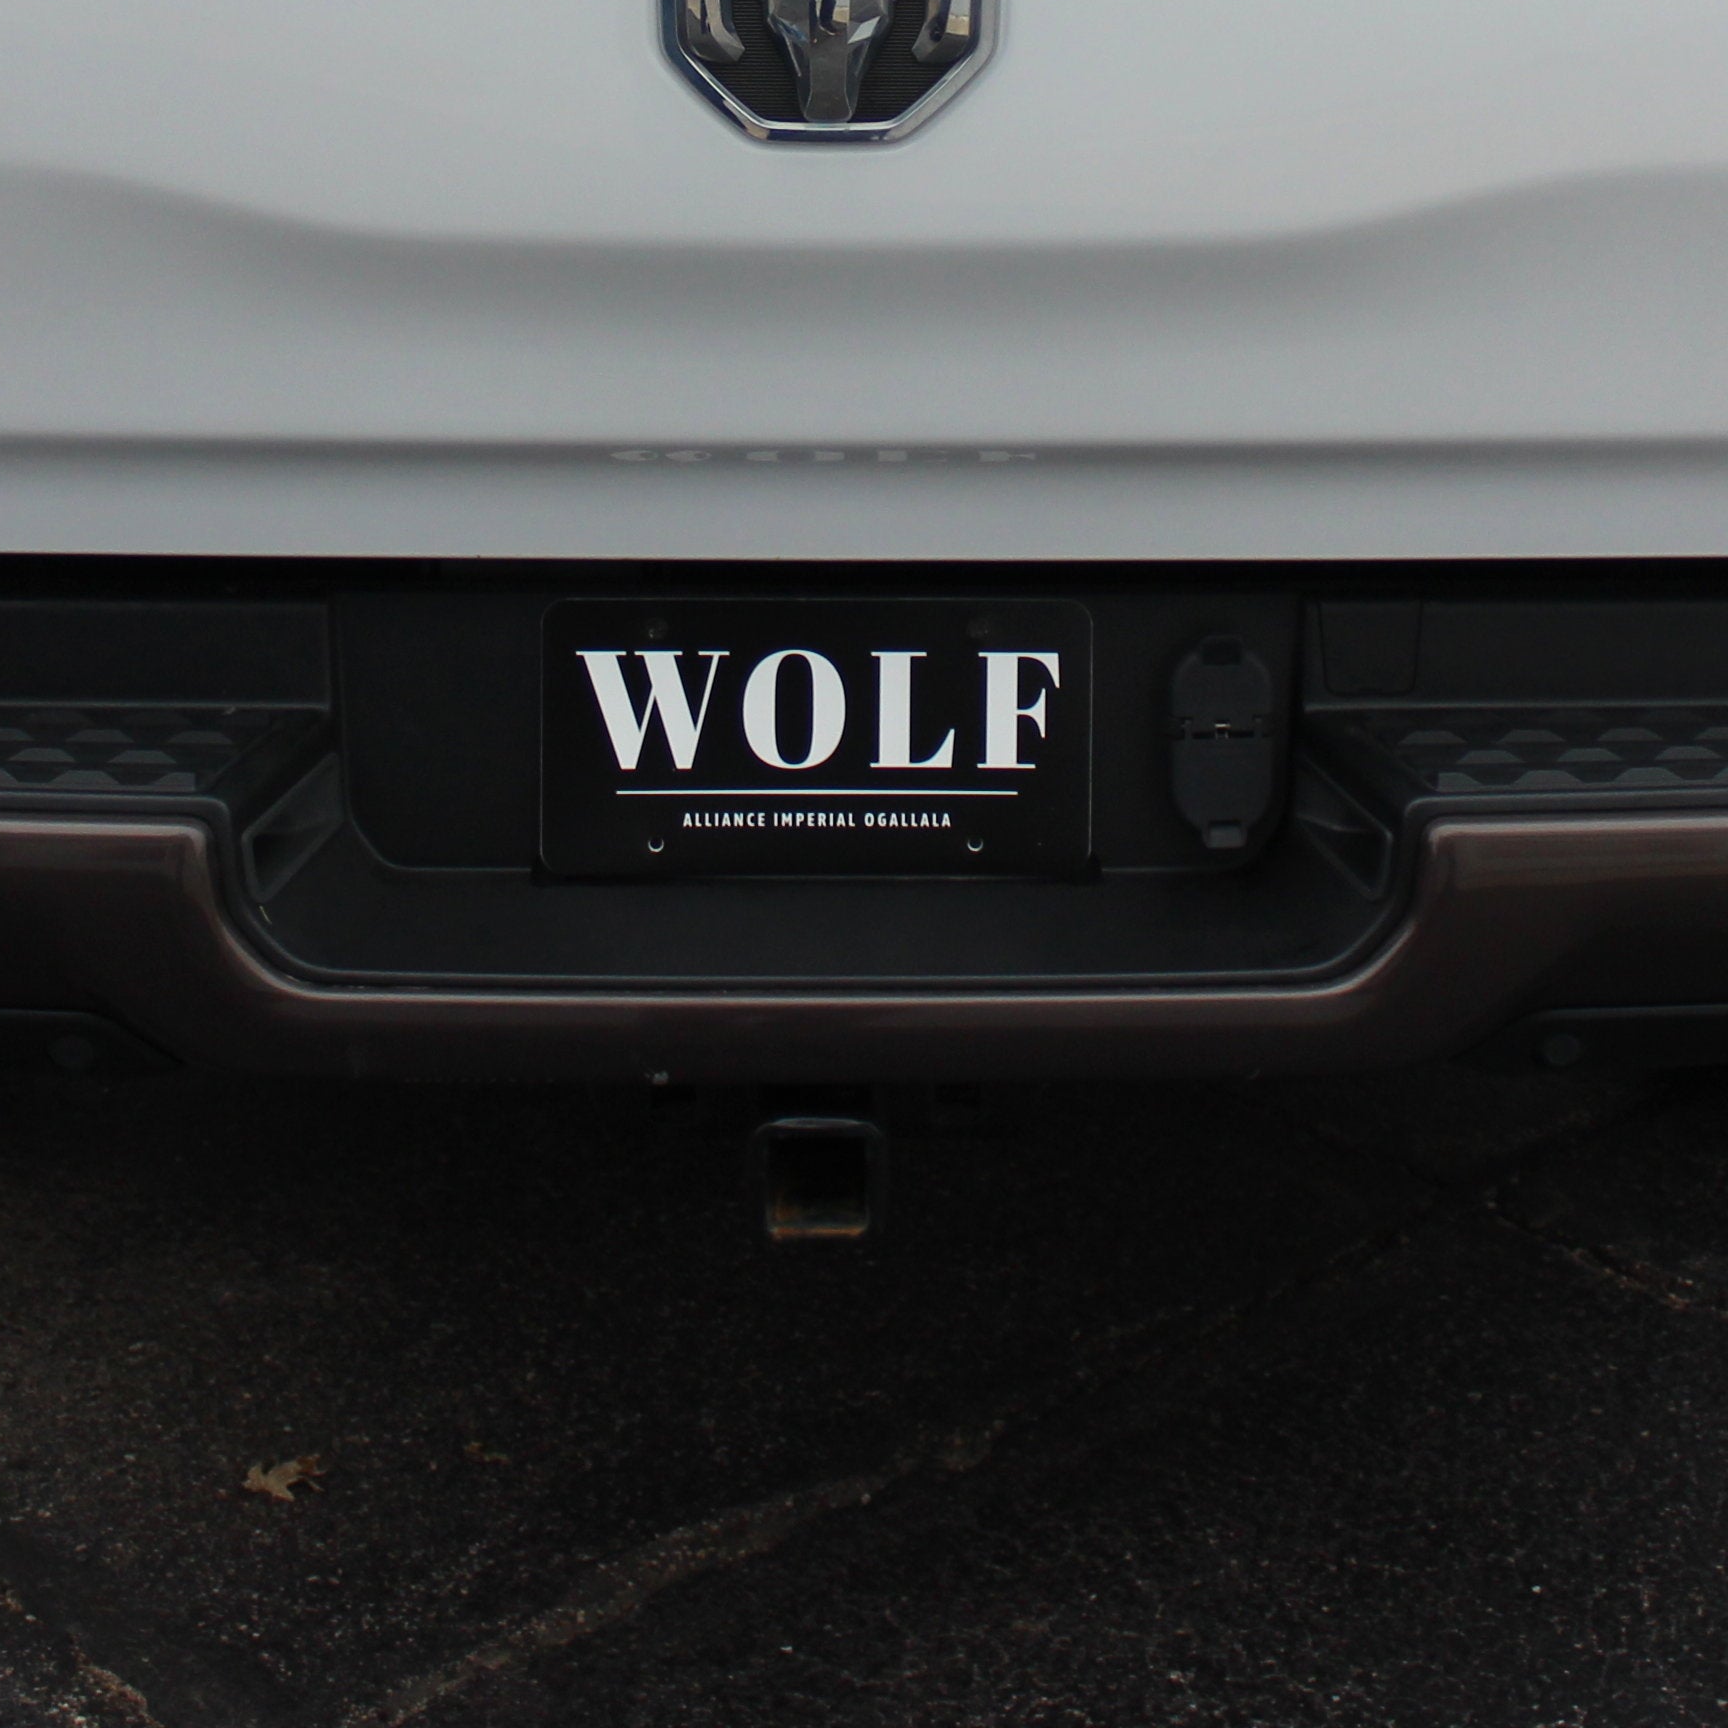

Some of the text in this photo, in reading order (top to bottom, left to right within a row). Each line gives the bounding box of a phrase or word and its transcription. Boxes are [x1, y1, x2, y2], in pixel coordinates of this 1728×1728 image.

[575, 649, 1060, 770] WOLF
[682, 812, 952, 828] ALLIANCE IMPERIAL OGALLALA
